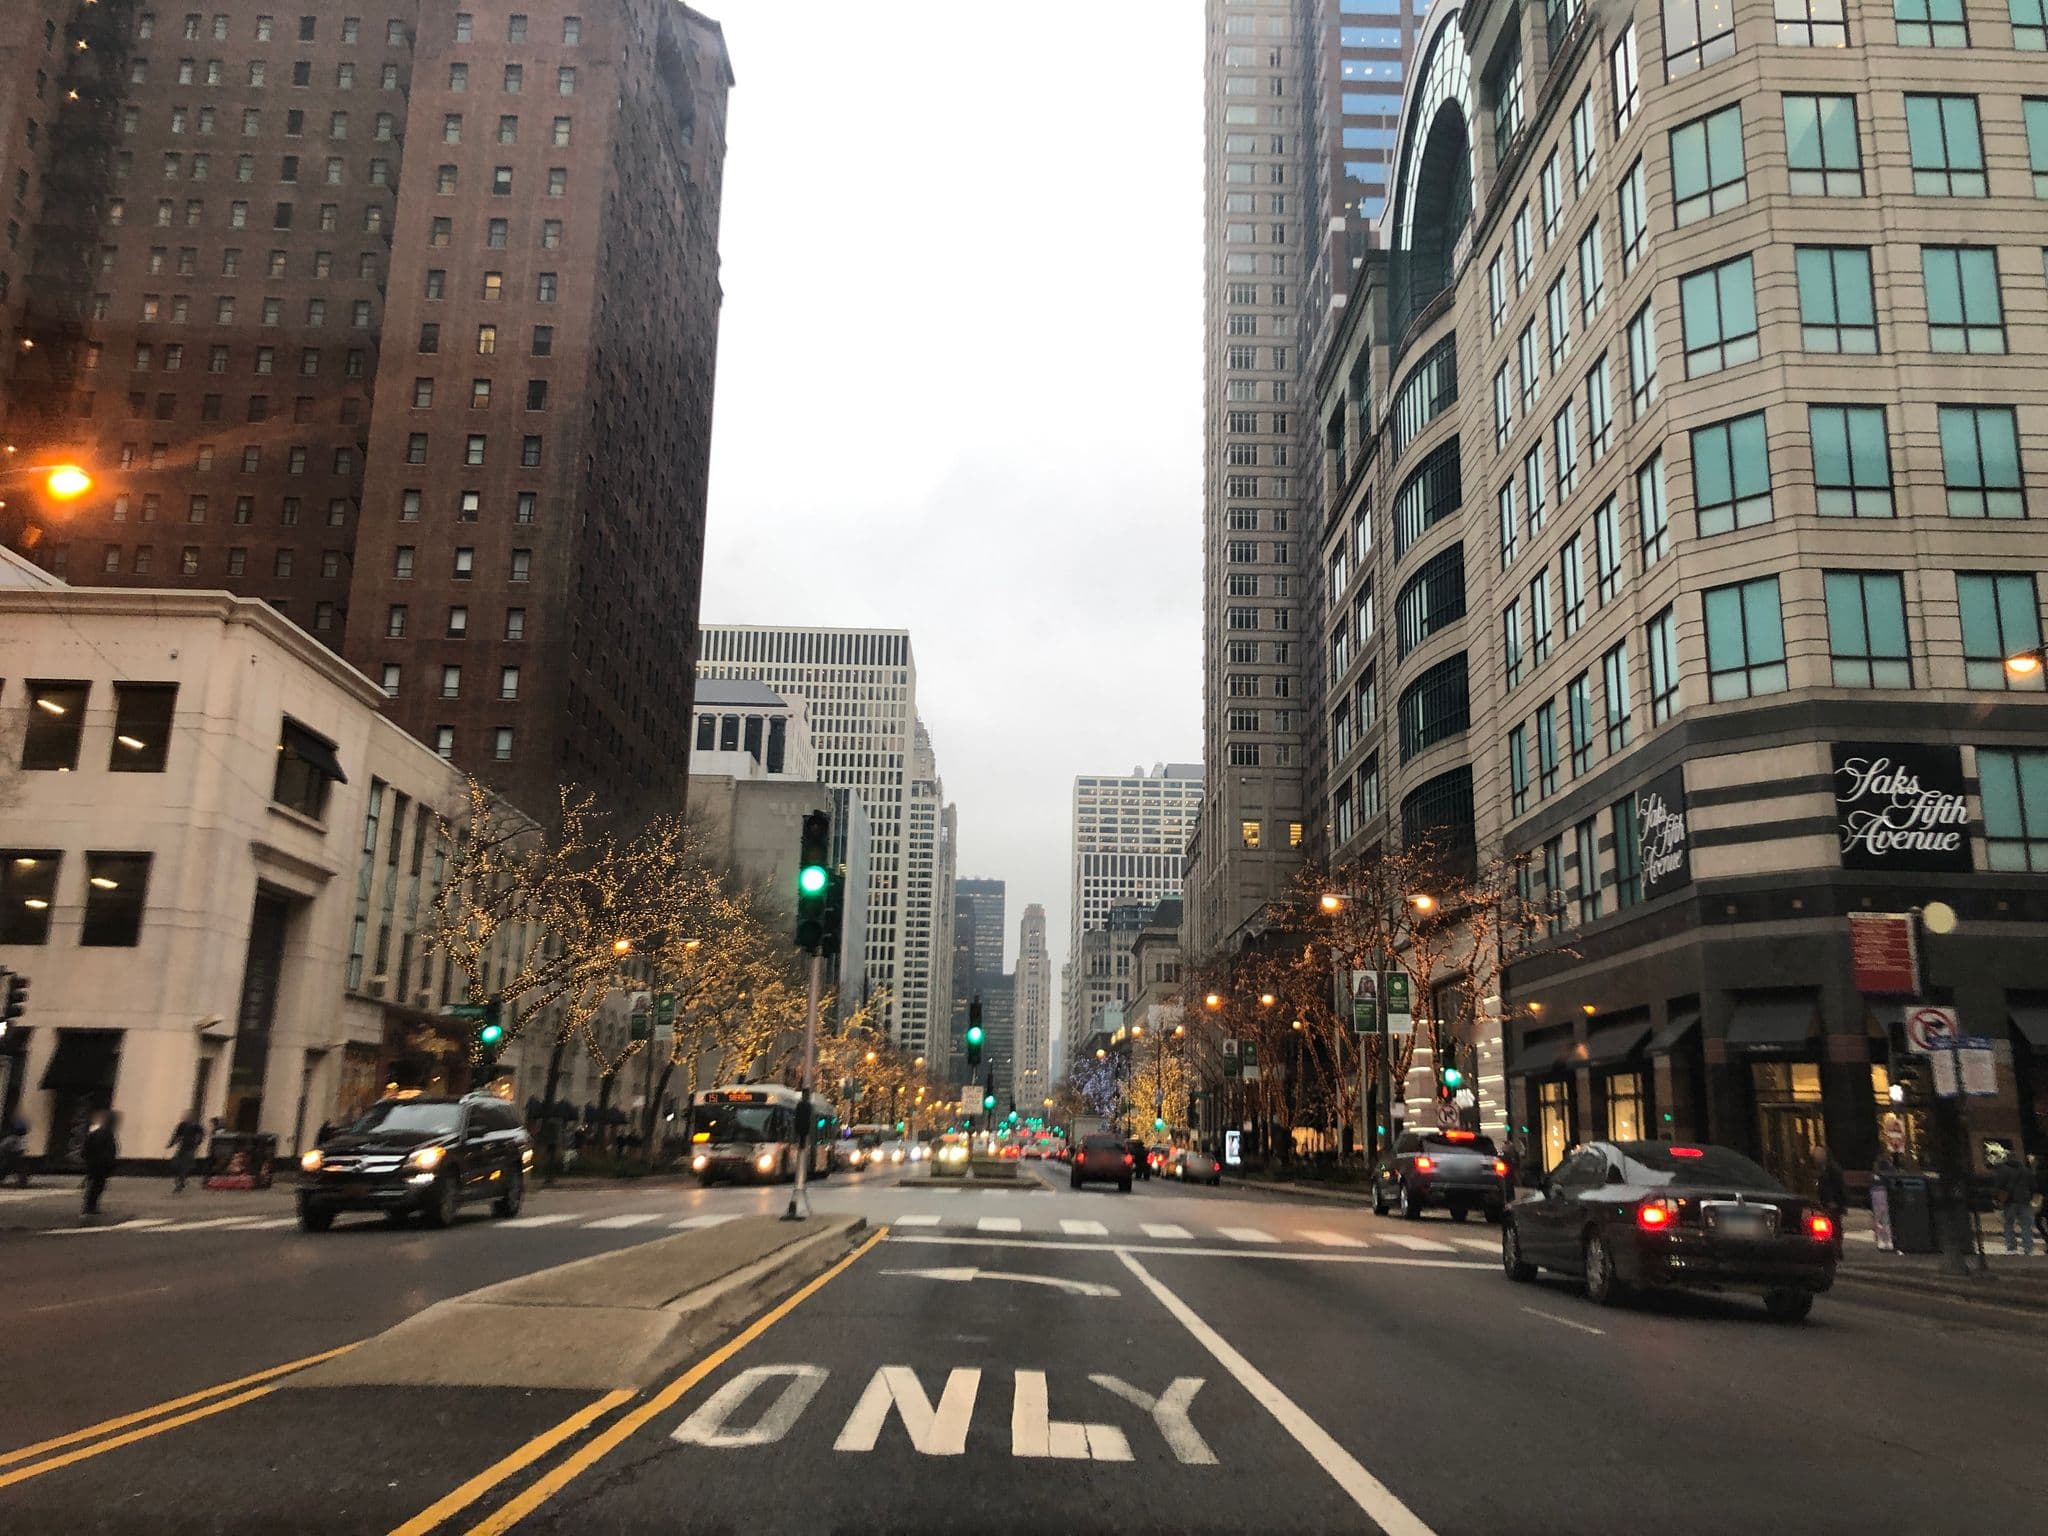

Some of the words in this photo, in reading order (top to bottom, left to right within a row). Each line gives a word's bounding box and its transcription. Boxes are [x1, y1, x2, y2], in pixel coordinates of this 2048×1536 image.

[1834, 757, 1921, 805] Saks
[1638, 792, 1668, 841] Saks
[1839, 809, 1961, 856] Avenue
[1882, 790, 1970, 830] Fifth
[1654, 813, 1686, 857] Fifth
[1640, 845, 1682, 885] Avenue
[670, 1365, 1220, 1465] ONLY
